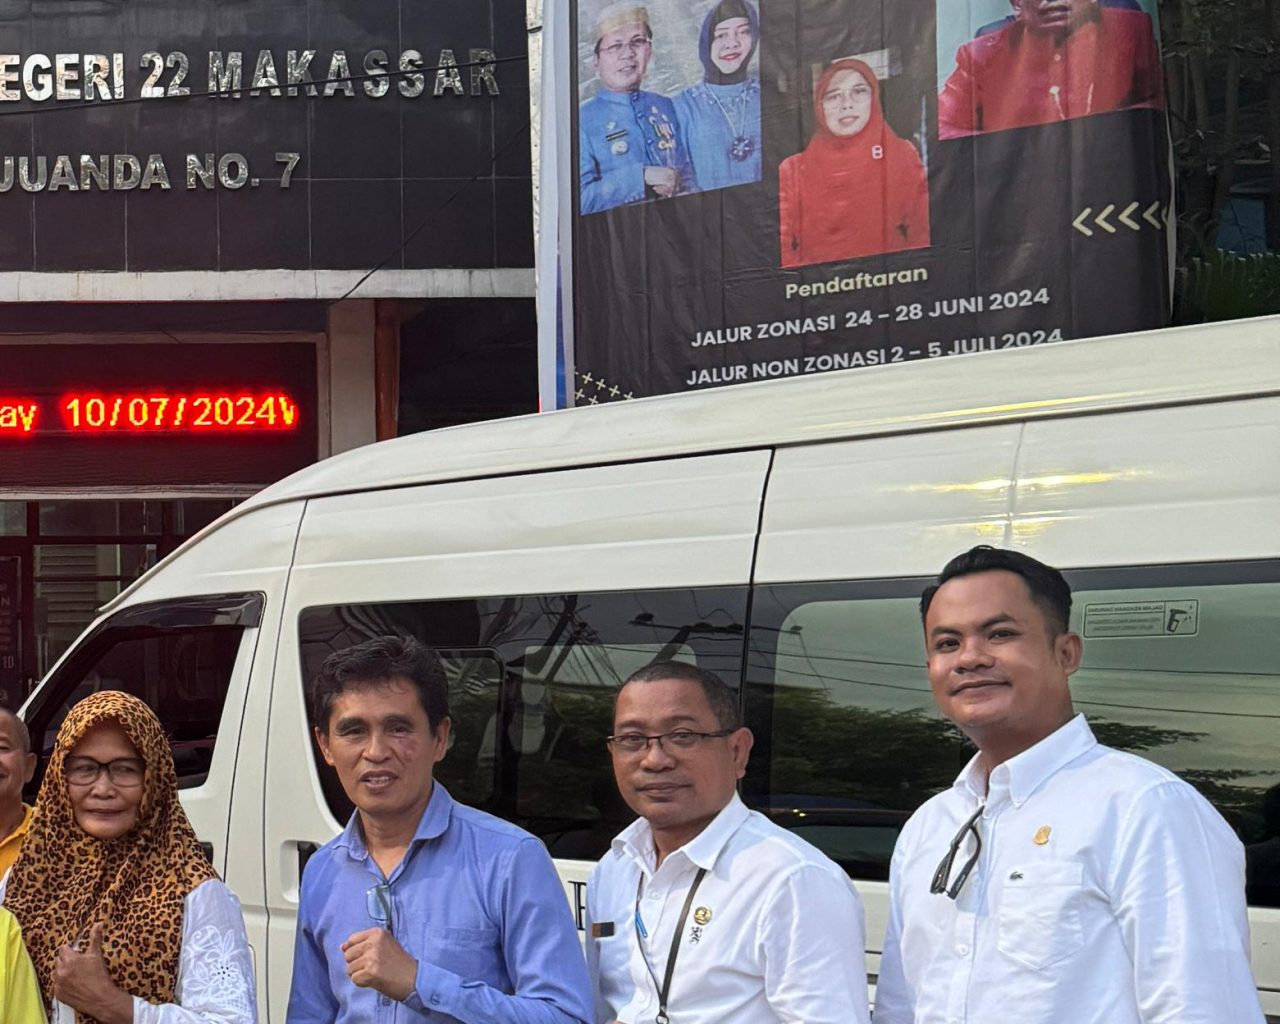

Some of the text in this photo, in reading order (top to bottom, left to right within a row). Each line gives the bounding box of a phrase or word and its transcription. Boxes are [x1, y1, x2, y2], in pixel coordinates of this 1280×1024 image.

[139, 51, 191, 98] 22
[208, 48, 500, 98] MAKASSAR
[186, 152, 260, 190] NO.
[275, 152, 300, 188] 7
[785, 267, 928, 299] Pendaftaran
[691, 325, 752, 348] JALUR
[757, 315, 836, 340] ZONASI
[845, 310, 873, 329] 24
[895, 304, 923, 323] 28
[928, 296, 983, 318] JUNI
[989, 287, 1050, 311] 2024
[686, 364, 748, 386] JALUR
[752, 359, 799, 378] NON
[804, 349, 886, 374] ZONASI
[891, 347, 905, 362] 2
[927, 342, 942, 357] 5
[947, 336, 996, 356] JULI
[1001, 328, 1063, 349] 2024
